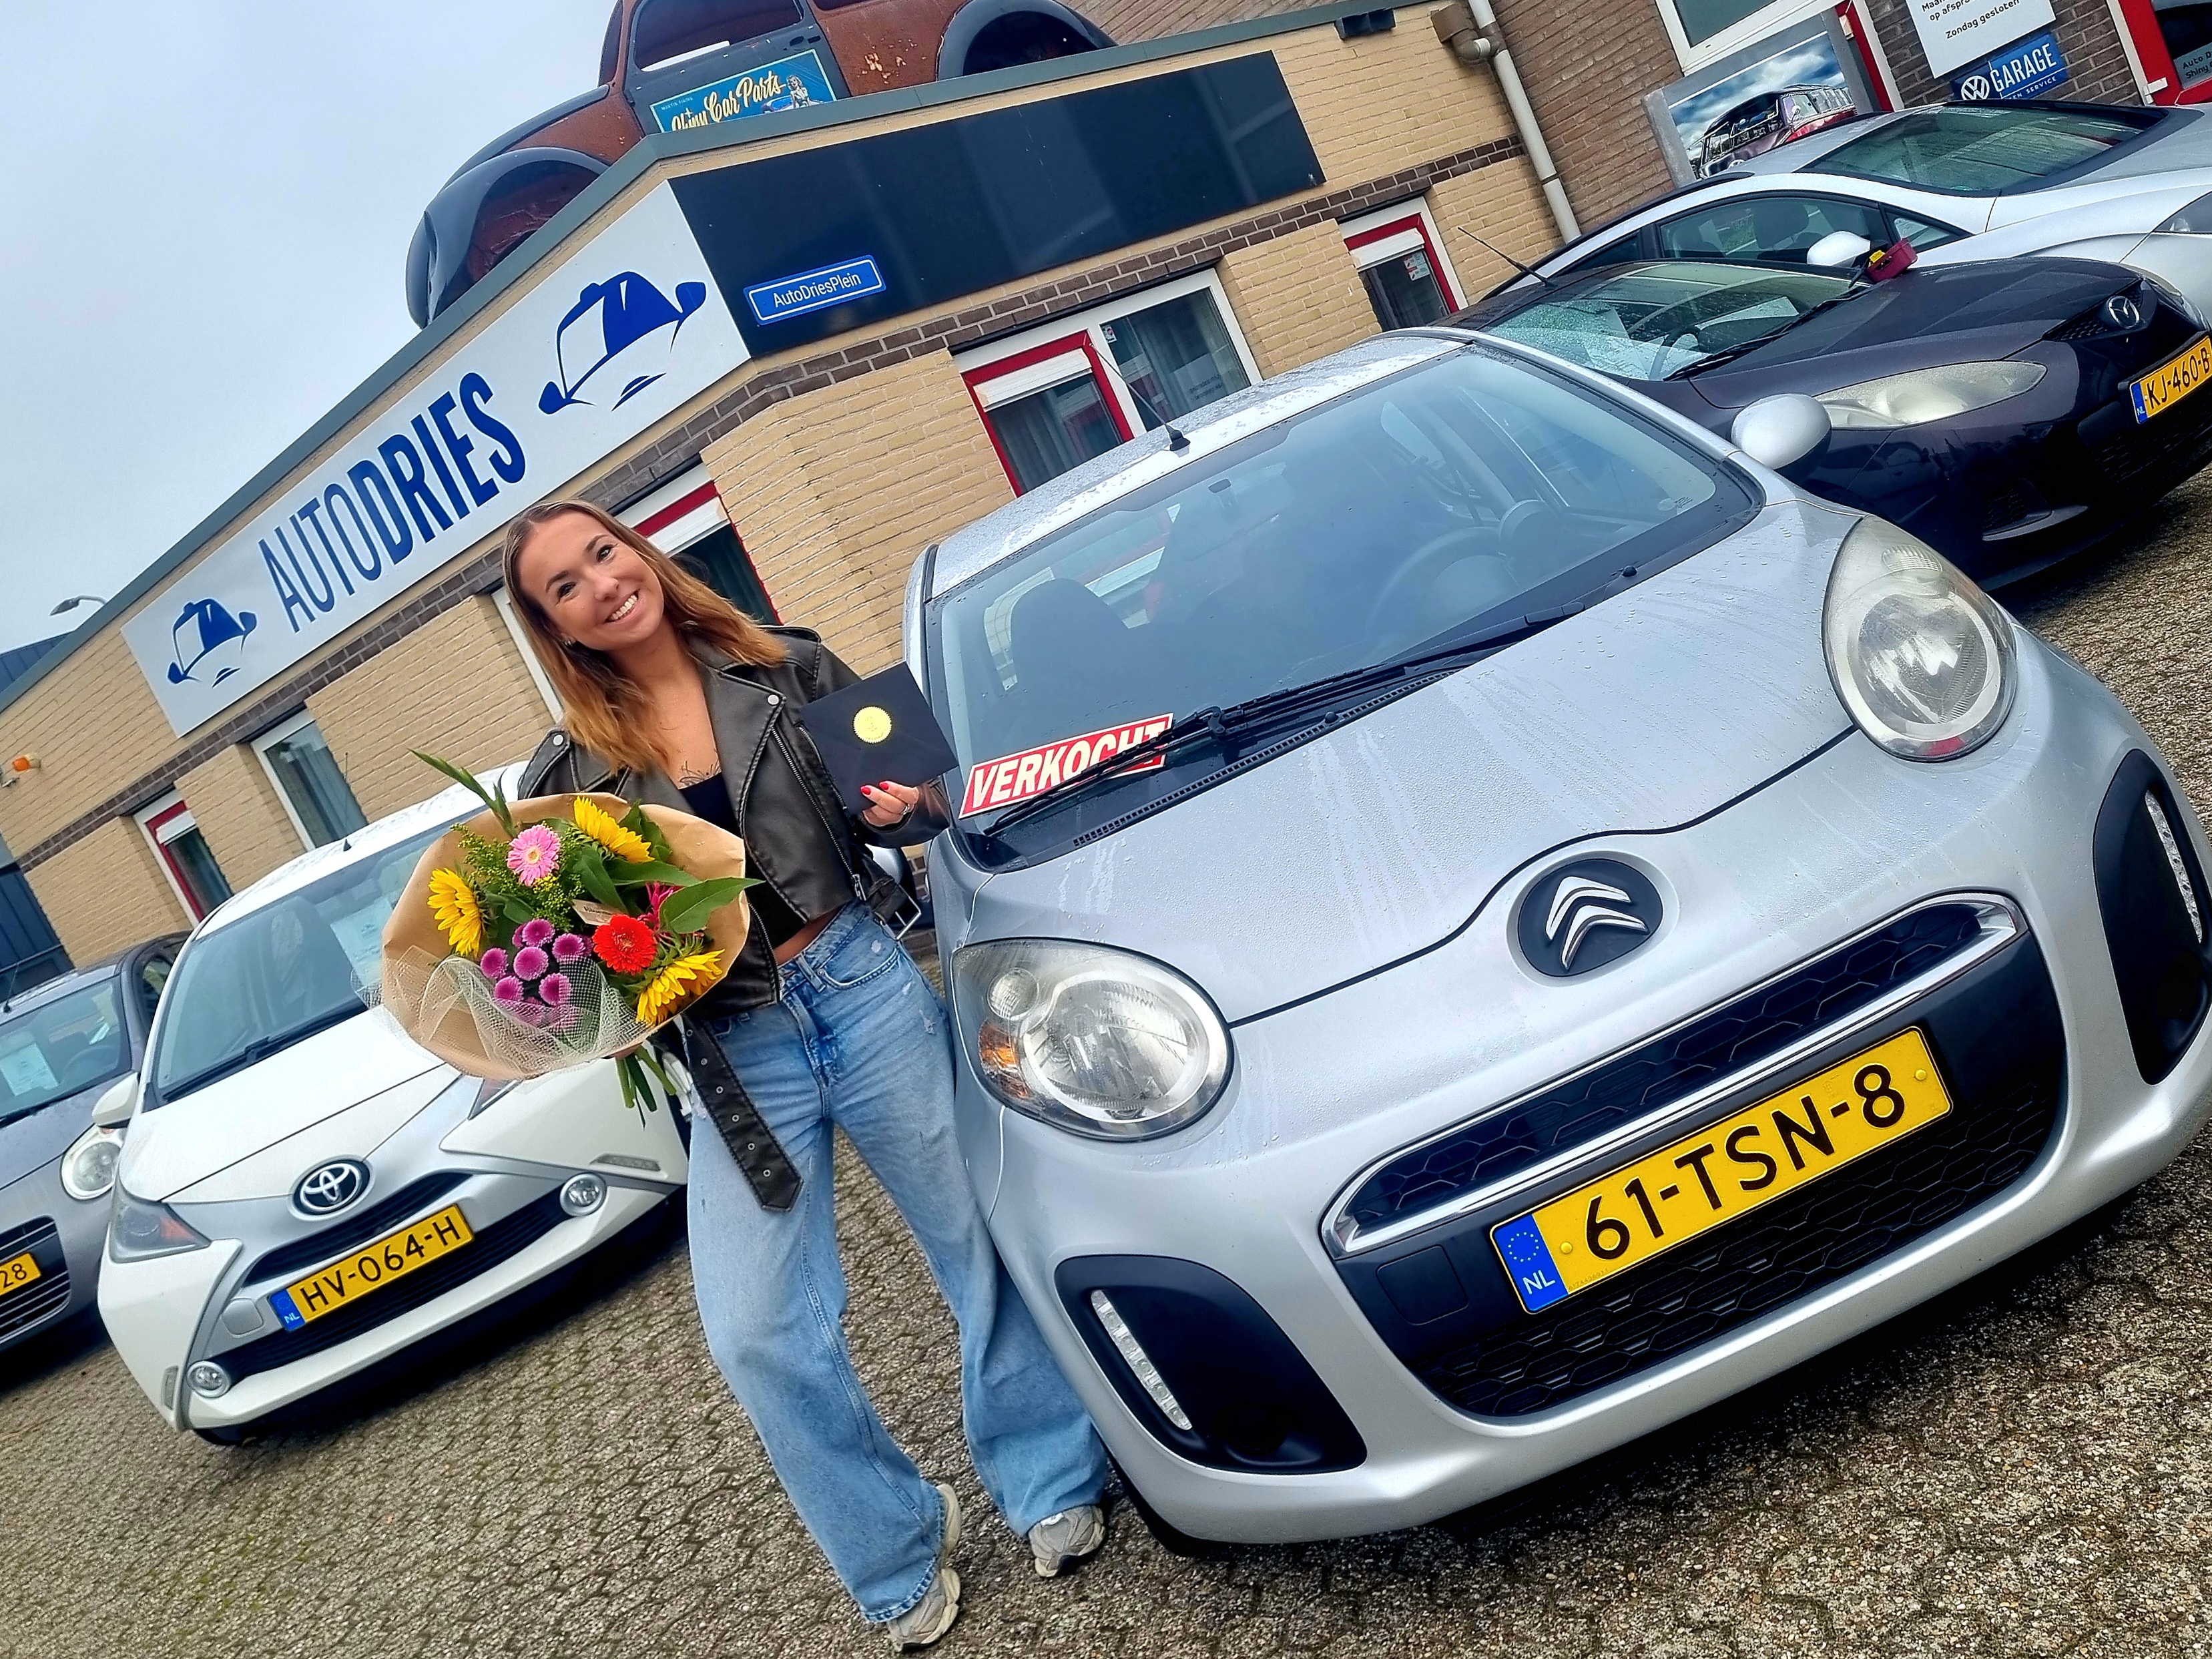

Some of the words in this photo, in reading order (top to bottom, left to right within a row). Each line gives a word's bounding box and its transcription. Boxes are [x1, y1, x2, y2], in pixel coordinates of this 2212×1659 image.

[1930, 12, 1940, 21] op
[1945, 19, 1978, 39] Zondag
[1980, 0, 2020, 24] gesloten
[1990, 43, 2057, 92] GARAGE
[2183, 56, 2203, 70] Auto
[2185, 65, 2209, 79] Shiny
[704, 90, 740, 123] Car
[736, 70, 787, 107] Parts
[2026, 76, 2056, 94] SERVICE
[773, 272, 862, 308] AutoDriesPlein
[2147, 346, 2210, 409] KJ-460-B
[258, 371, 527, 634] AUTODRIES
[973, 721, 1167, 809] VERKOCHT
[1584, 1063, 1906, 1260] 61-TSN-8
[300, 1215, 461, 1313] HV-064-H
[1523, 1268, 1556, 1295] NL
[284, 1312, 300, 1324] NL
